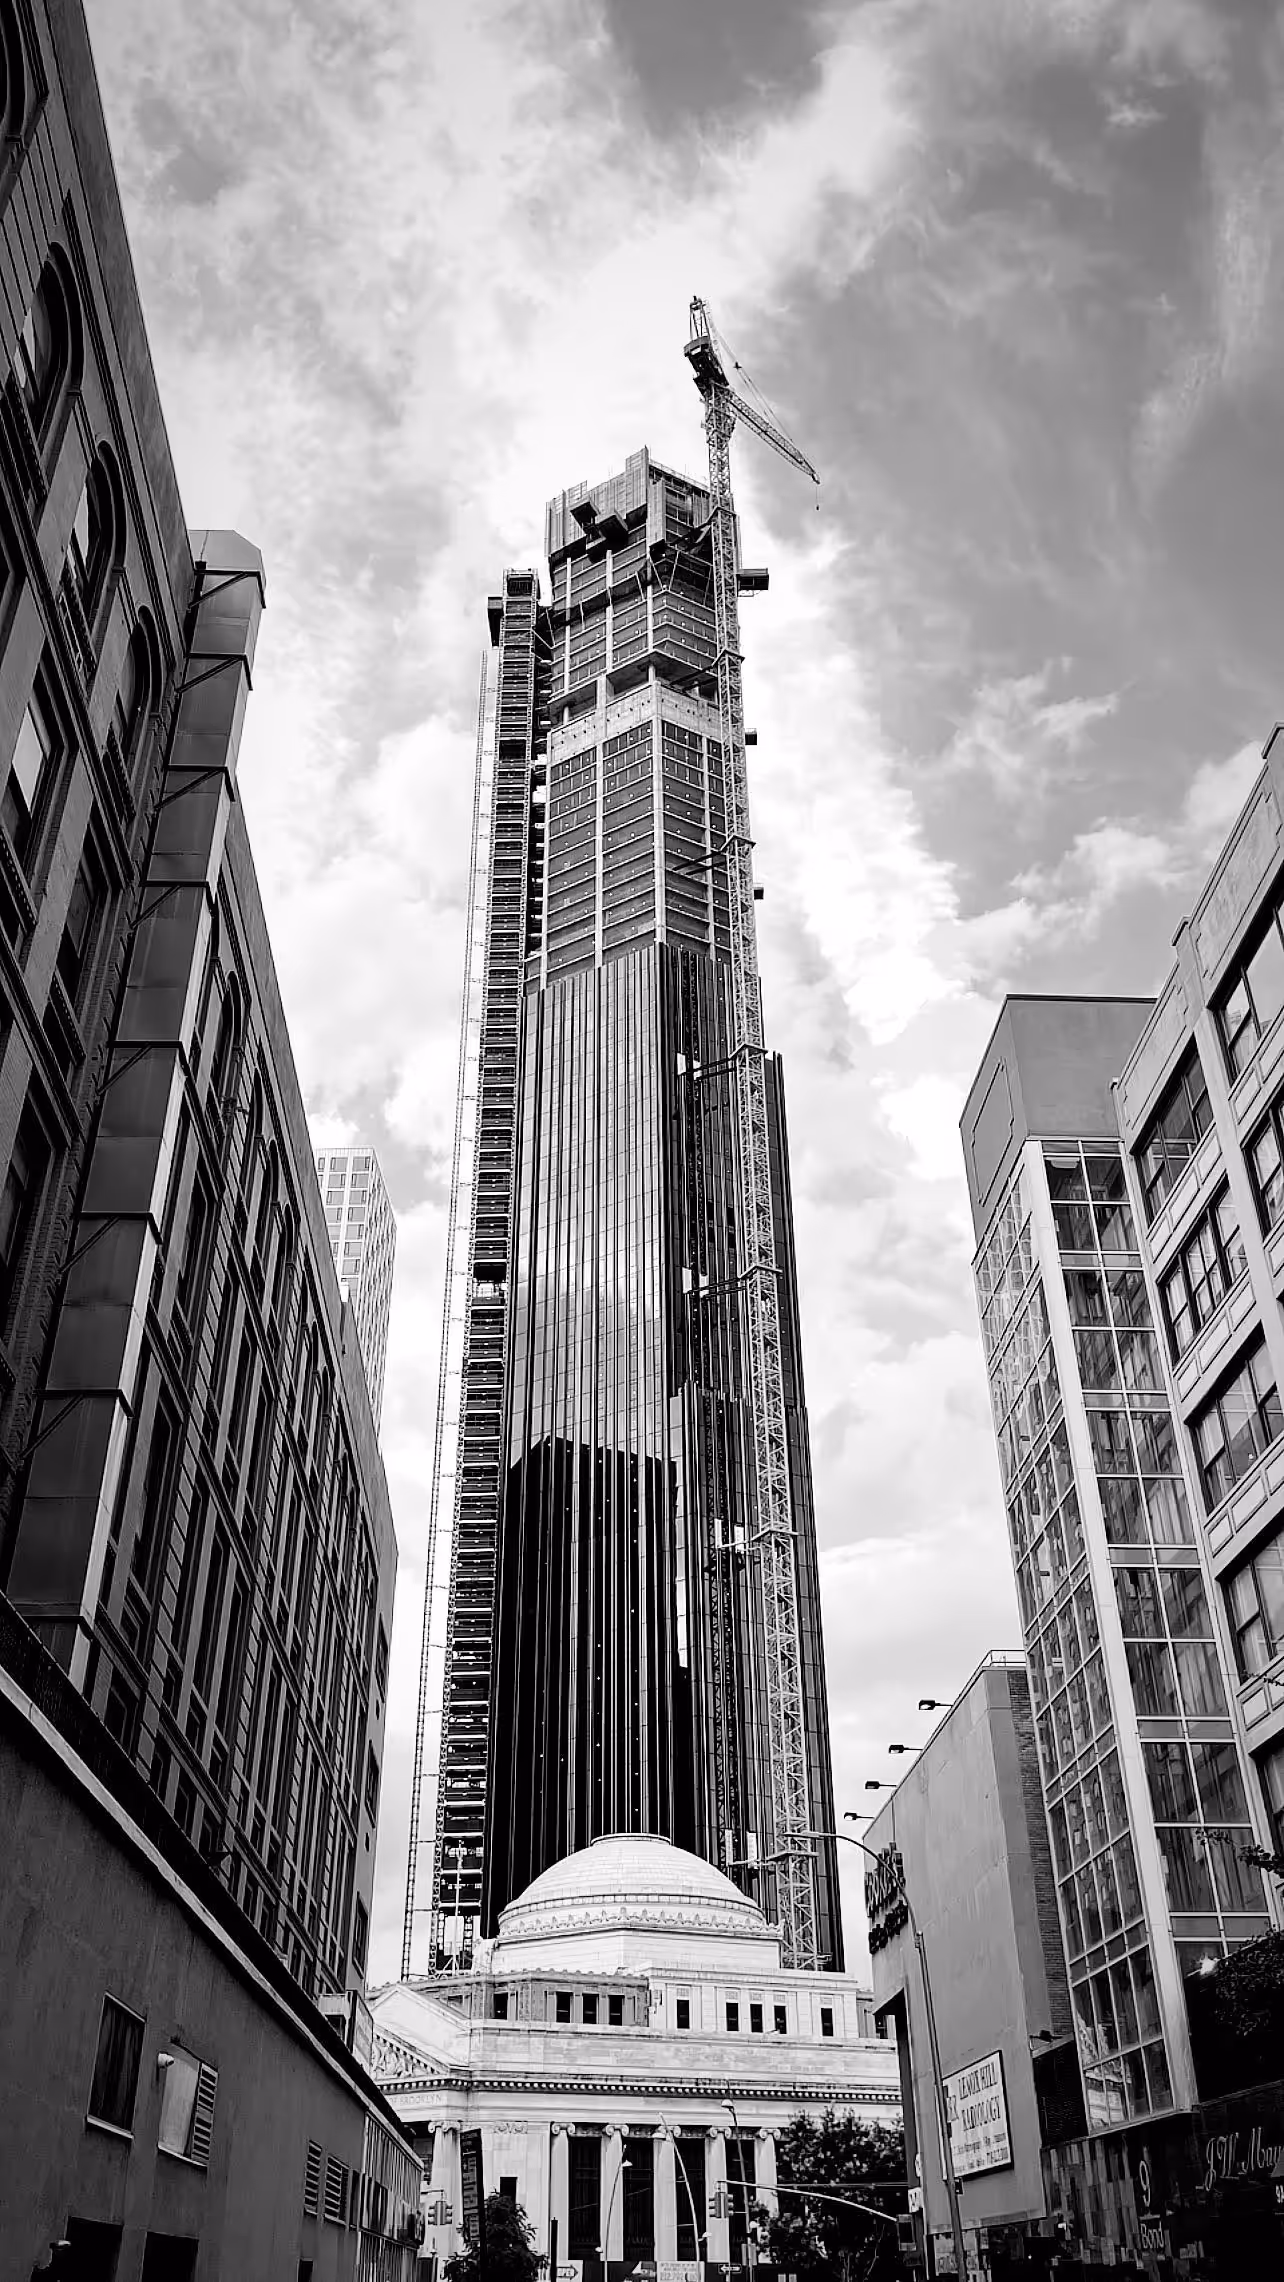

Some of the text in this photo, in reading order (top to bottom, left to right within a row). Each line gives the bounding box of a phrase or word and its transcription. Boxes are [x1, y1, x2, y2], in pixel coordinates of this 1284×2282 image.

[980, 2062, 998, 2090] HILL
[400, 2093, 441, 2106] BROOKLYN
[1140, 2220, 1164, 2249] Bond
